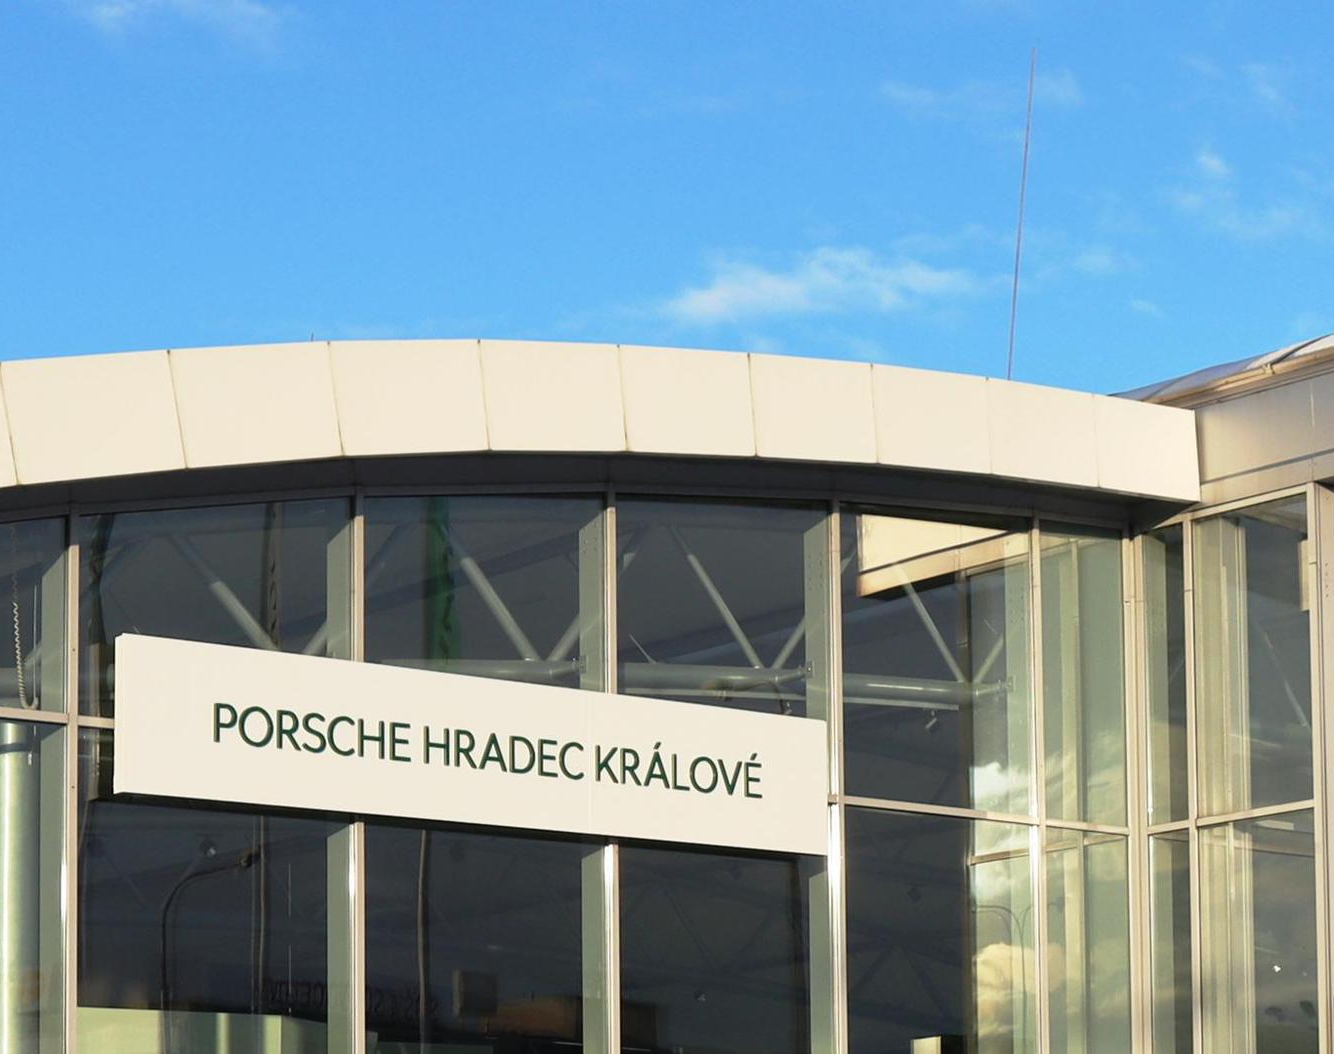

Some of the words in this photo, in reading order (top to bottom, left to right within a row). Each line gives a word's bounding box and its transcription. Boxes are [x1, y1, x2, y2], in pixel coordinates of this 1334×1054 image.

[213, 701, 413, 763] PORSCHE
[422, 725, 585, 781] HRADEC
[595, 741, 764, 800] KRÁLOVÉ
